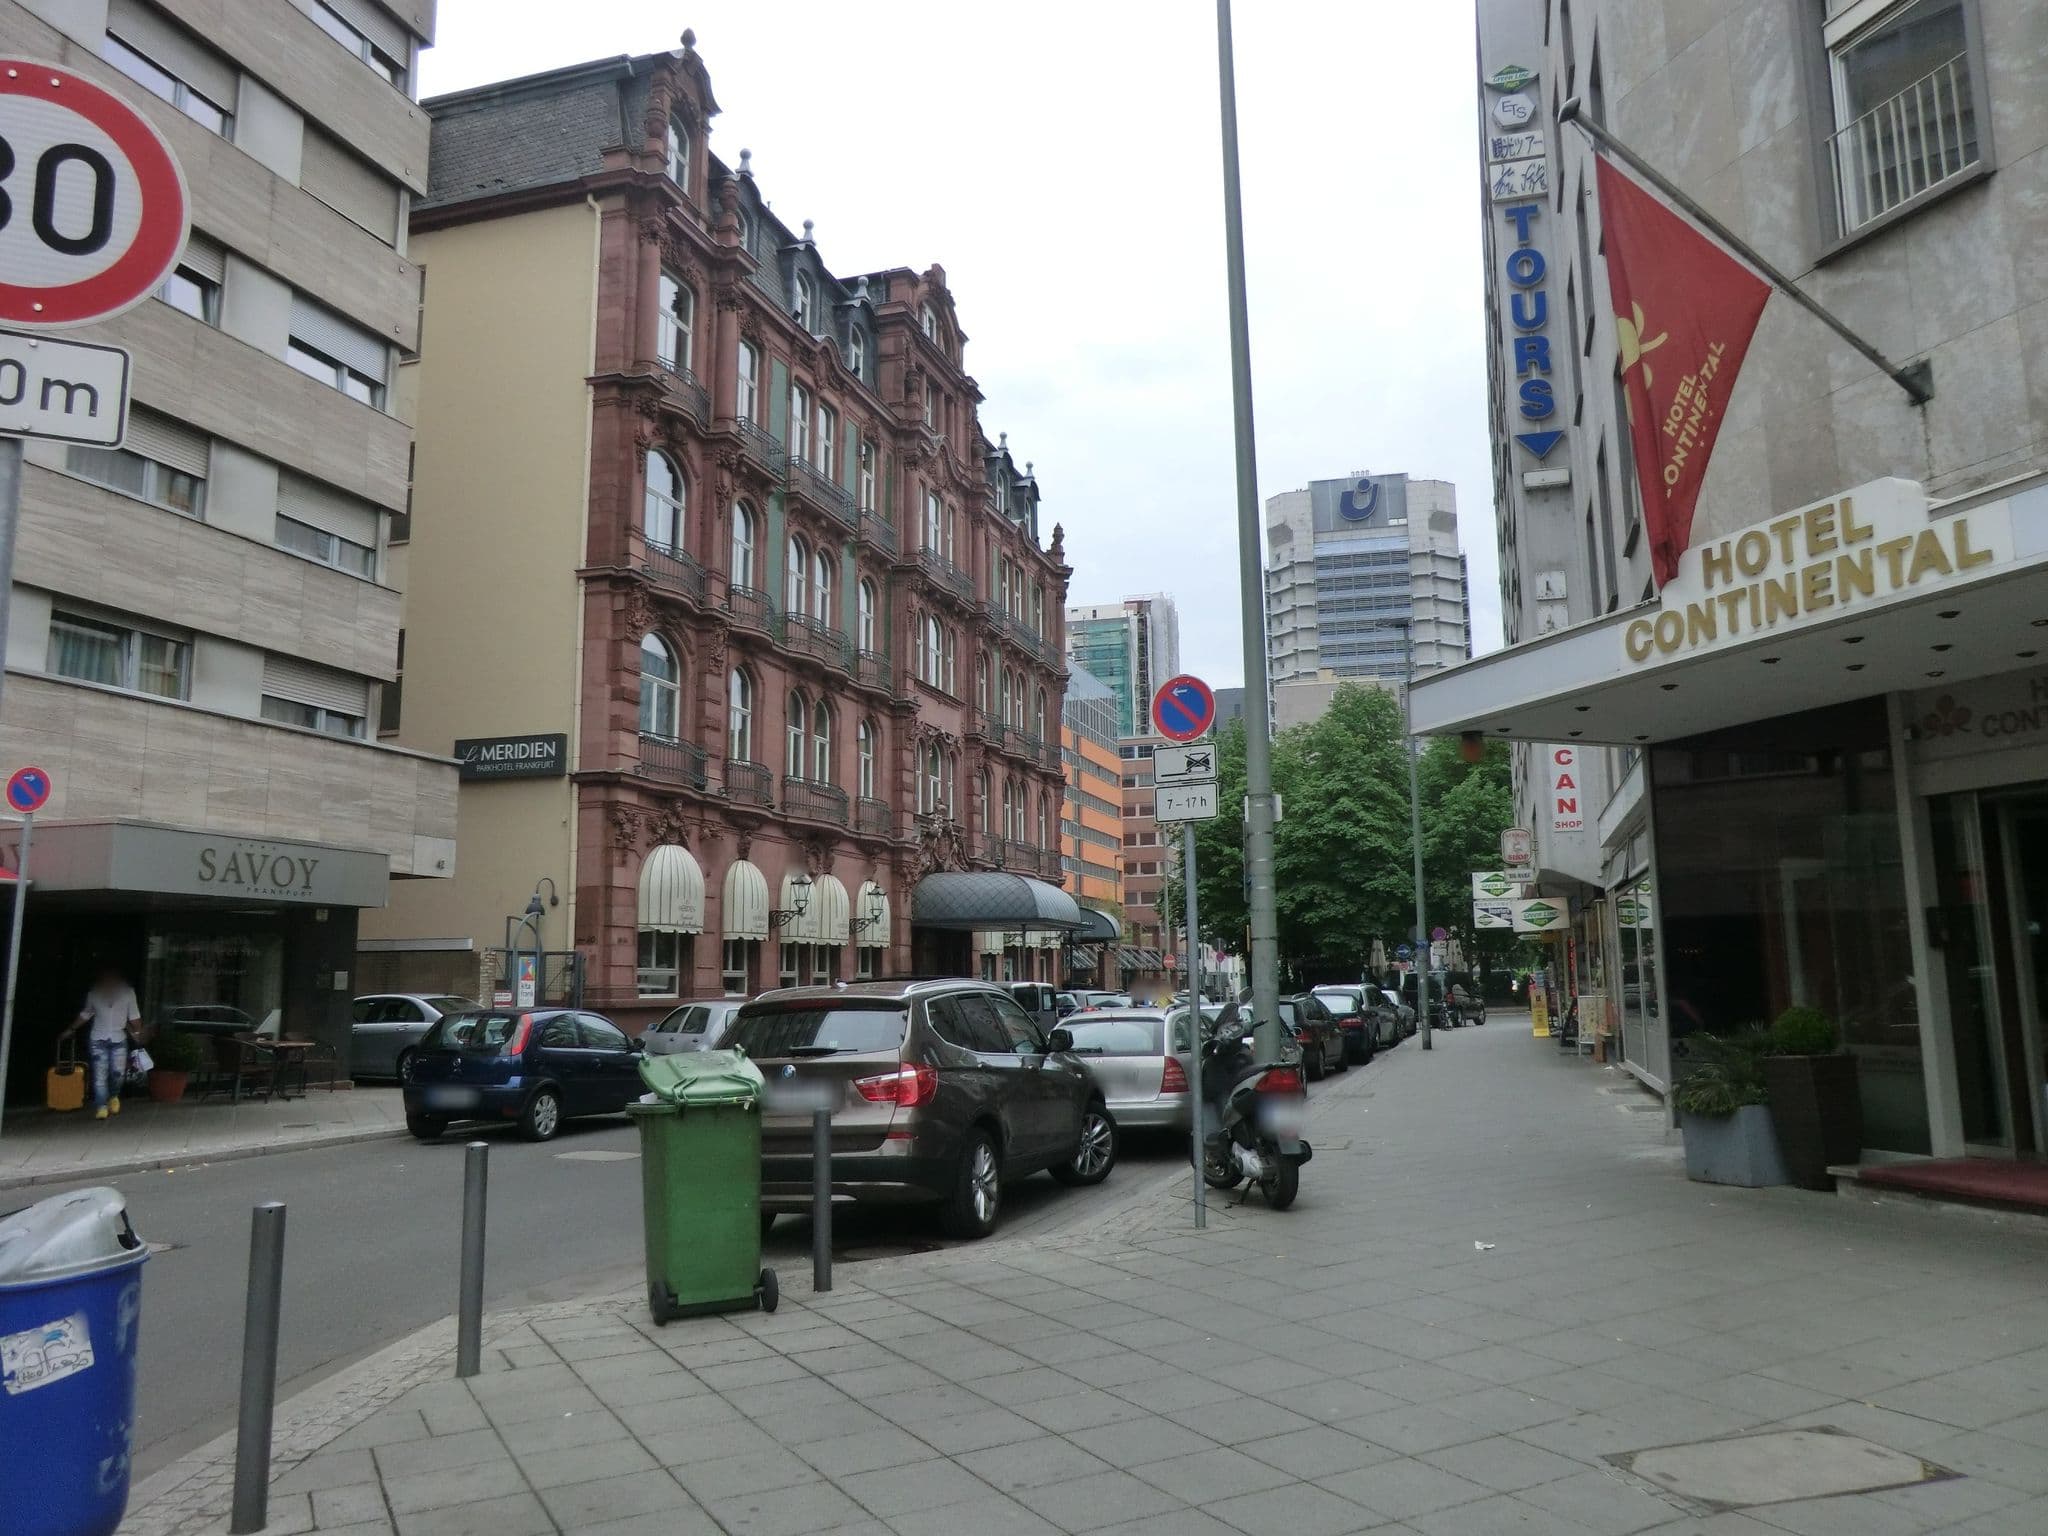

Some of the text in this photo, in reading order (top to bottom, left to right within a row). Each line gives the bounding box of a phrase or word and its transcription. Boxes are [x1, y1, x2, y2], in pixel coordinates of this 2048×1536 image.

[1502, 100, 1527, 118] ETS
[1505, 204, 1555, 420] TOURS
[1662, 374, 1697, 438] HOTEL
[1663, 341, 1726, 498] ONTINENTAL
[1702, 497, 1874, 590] HOTEL
[1625, 519, 1993, 662] CONTINENTAL
[480, 741, 556, 761] MERIDIEN
[515, 760, 555, 771] FRANKFURT
[1554, 820, 1583, 829] SHOP
[198, 848, 319, 889] SAVOY
[246, 886, 313, 897] FRANKFURT
